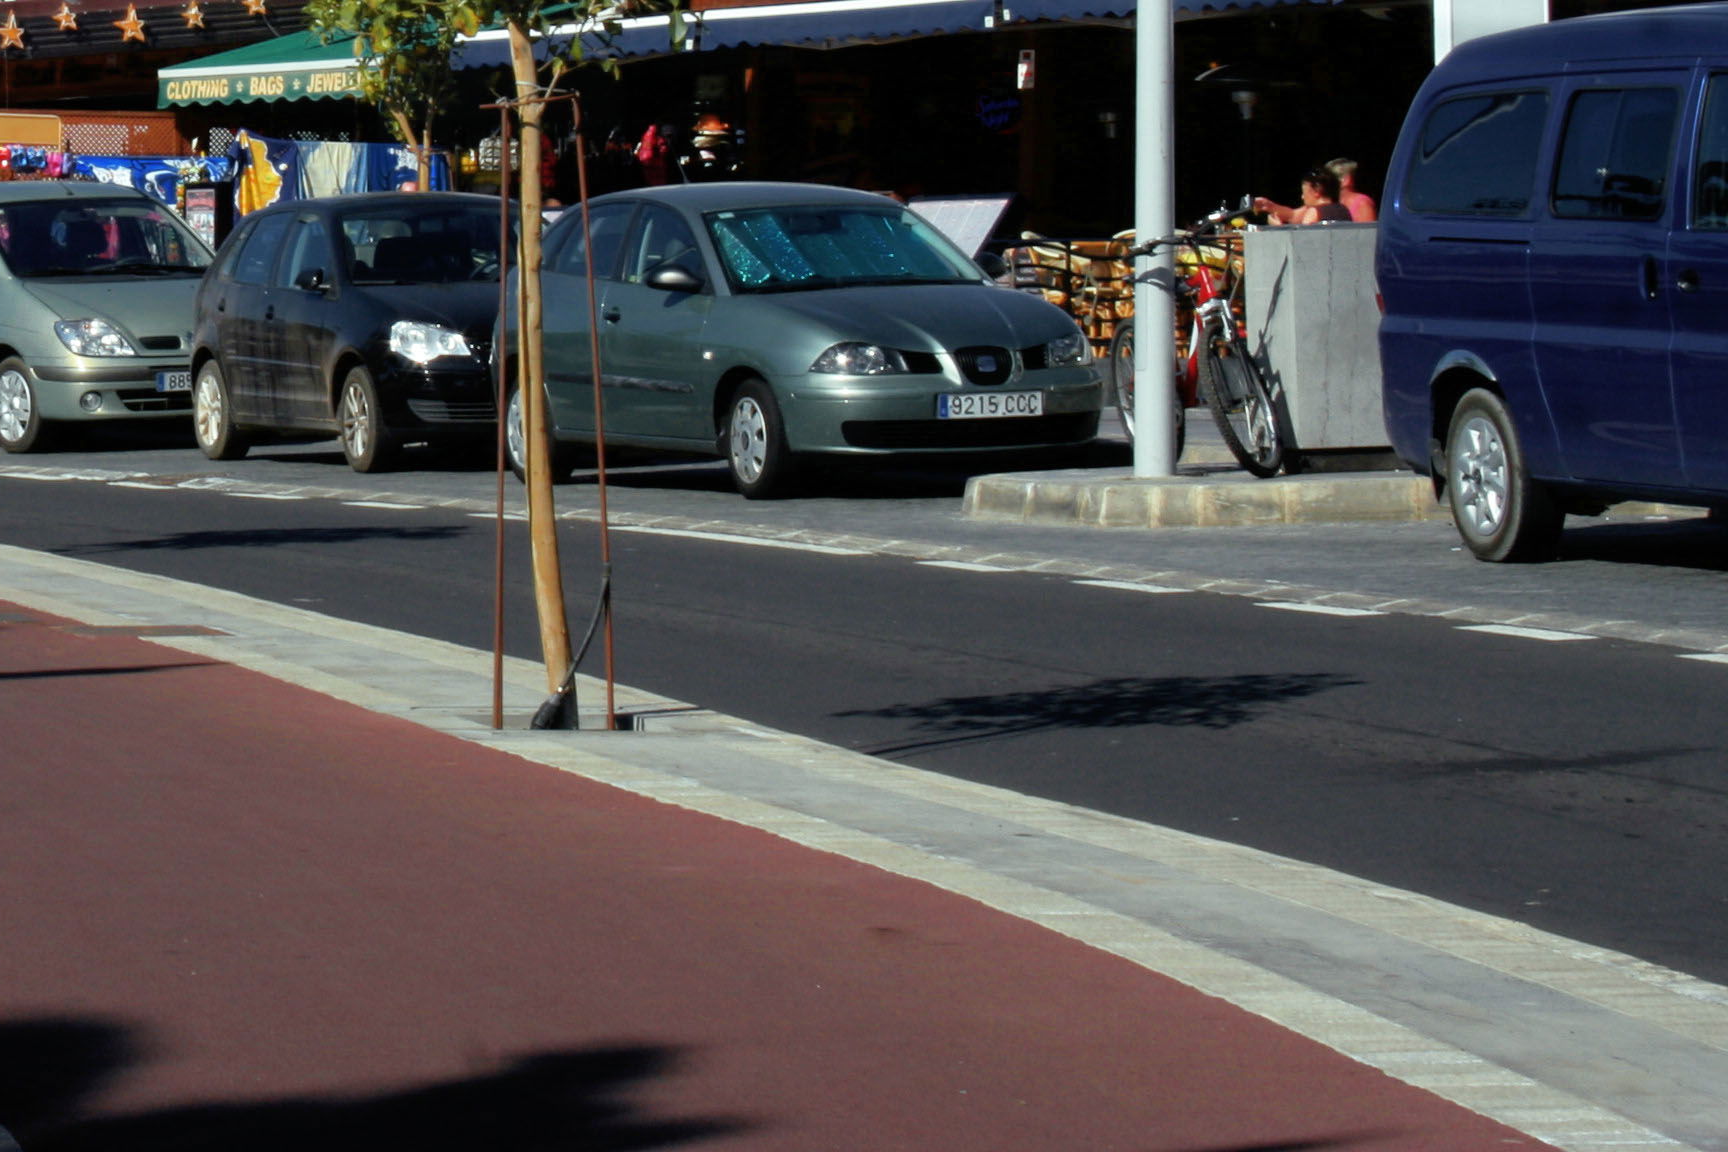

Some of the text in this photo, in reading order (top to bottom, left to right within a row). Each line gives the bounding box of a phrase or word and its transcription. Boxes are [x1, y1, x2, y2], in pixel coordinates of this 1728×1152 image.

[166, 78, 230, 100] CLOTHING
[250, 75, 284, 96] BAGS
[952, 394, 1038, 415] 9215 CCC
